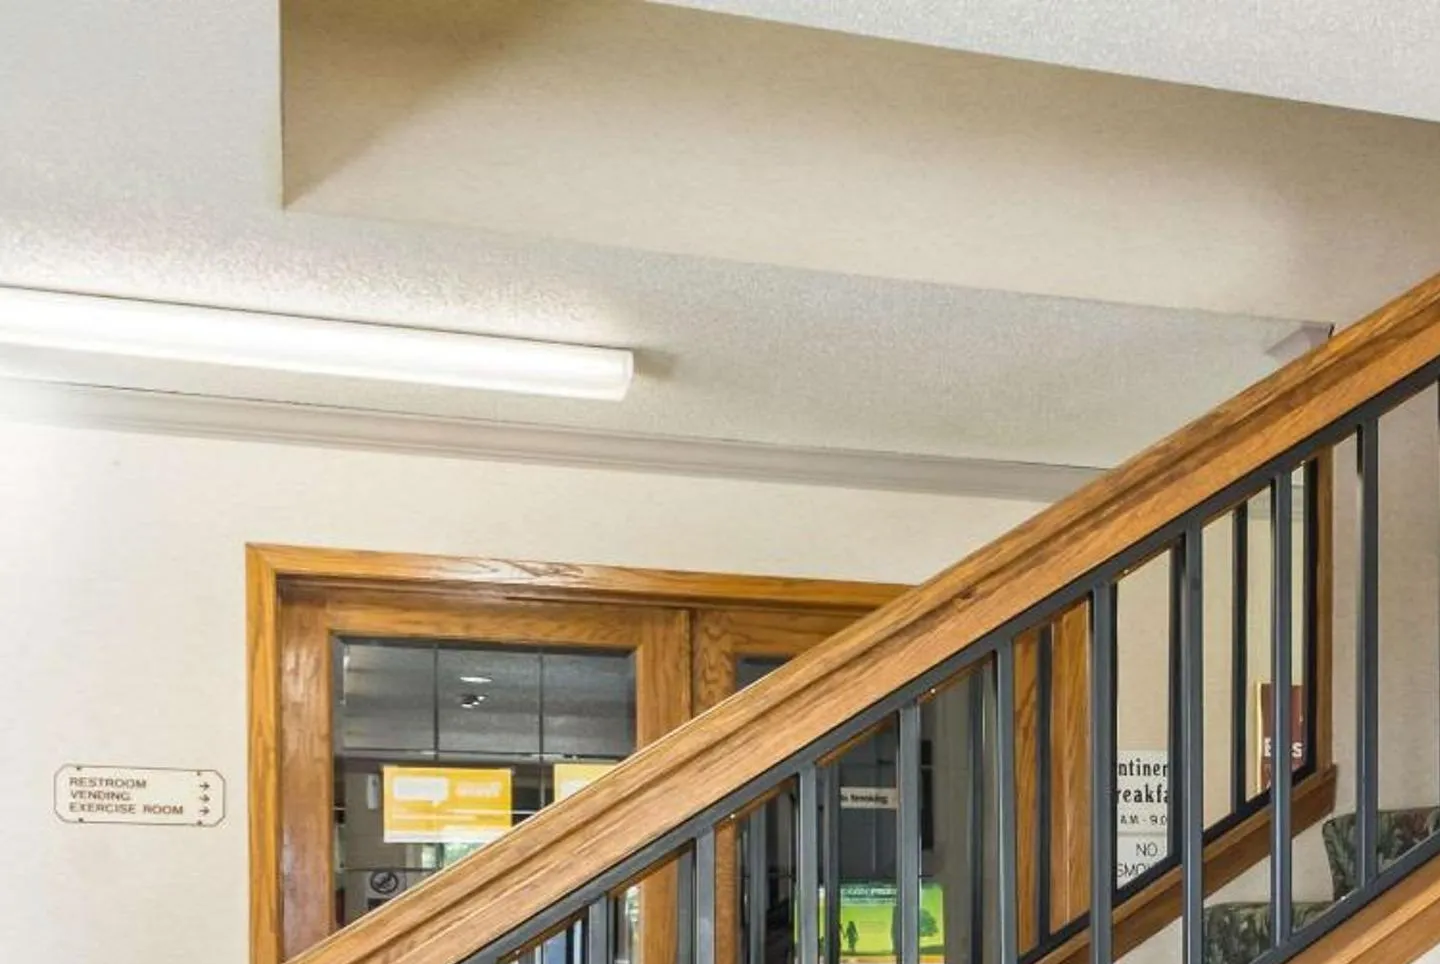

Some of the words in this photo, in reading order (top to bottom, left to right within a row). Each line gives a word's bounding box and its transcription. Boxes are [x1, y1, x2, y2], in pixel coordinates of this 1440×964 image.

[69, 777, 147, 789] RESTROOM
[70, 789, 131, 801] VENDING
[69, 802, 136, 814] EXERCISE
[143, 804, 184, 815] ROOM
[1135, 842, 1158, 857] NO
